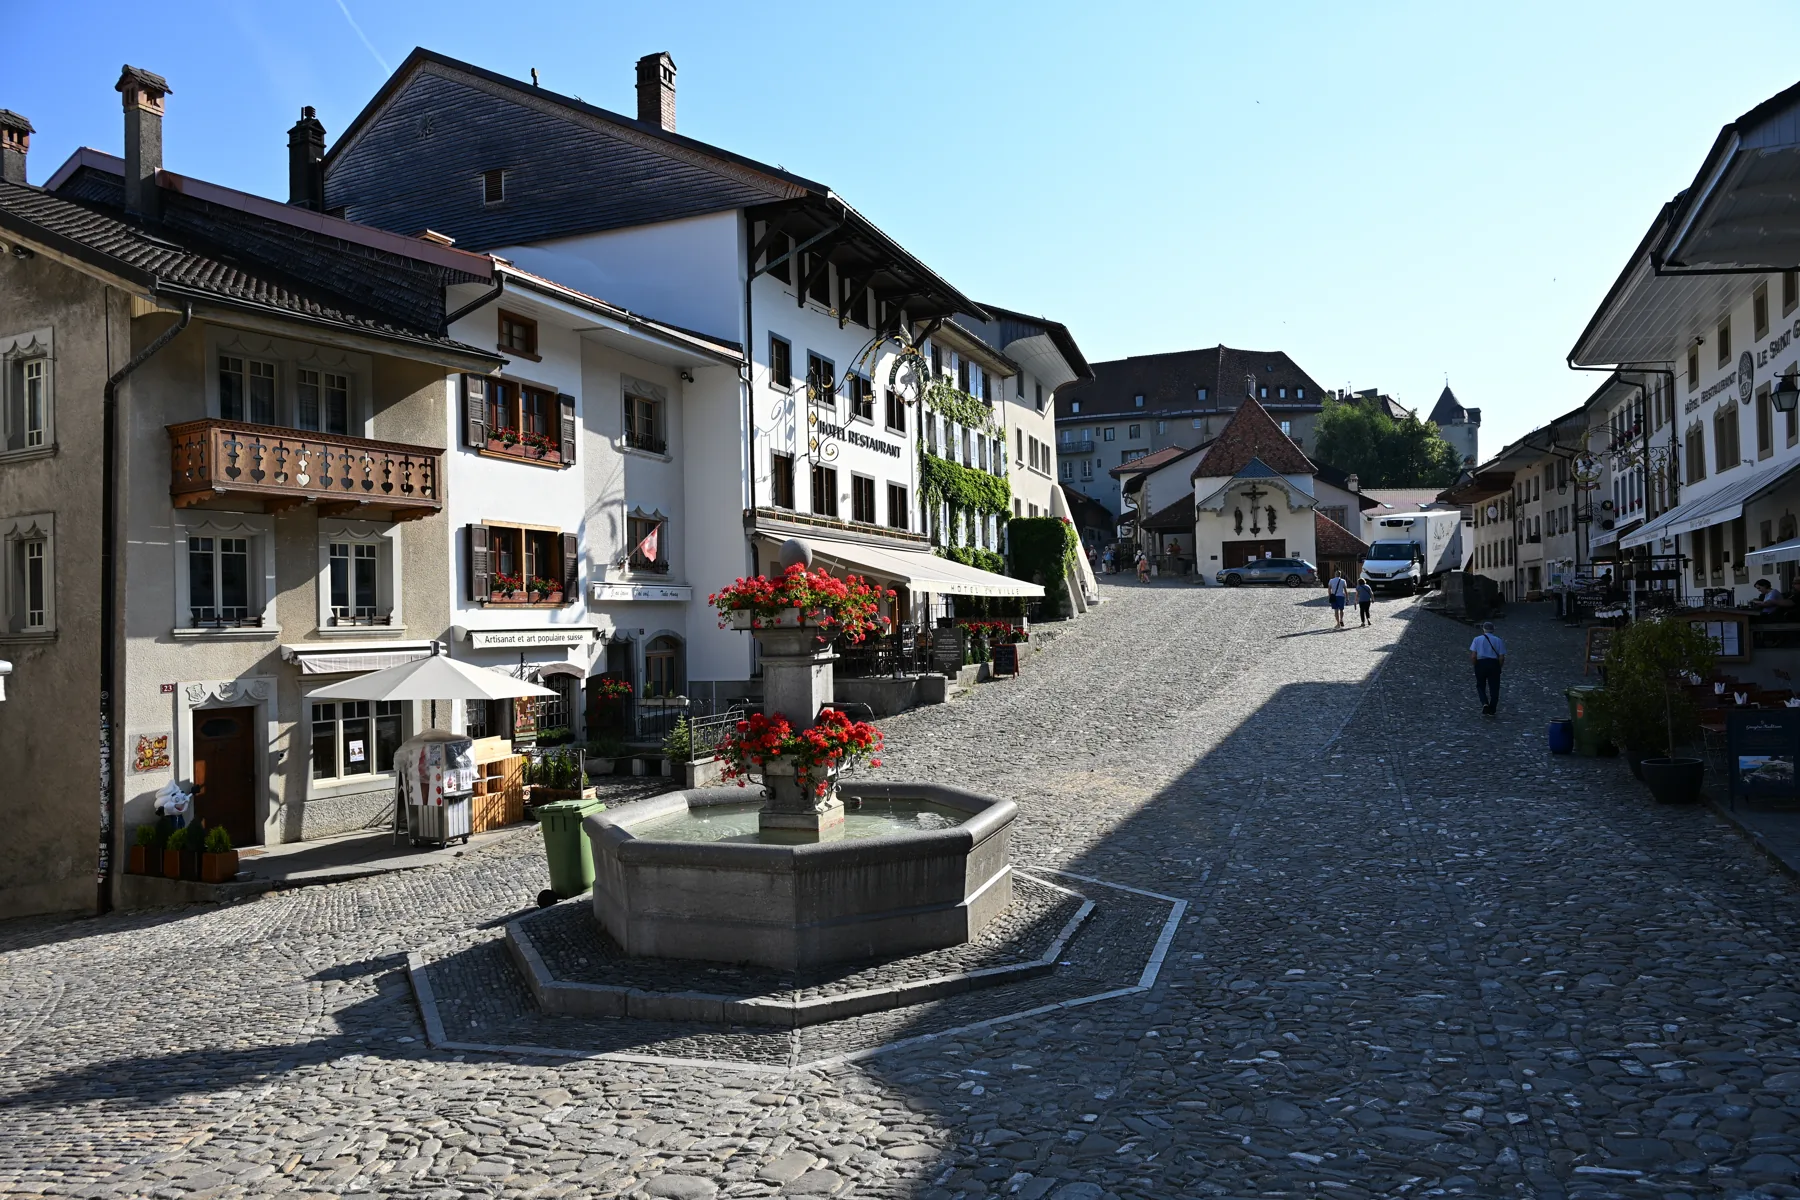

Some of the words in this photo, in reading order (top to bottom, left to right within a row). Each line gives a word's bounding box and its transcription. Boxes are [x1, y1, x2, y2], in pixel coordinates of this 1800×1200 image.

[917, 358, 929, 375] VILLE
[1757, 349, 1768, 369] LE
[1701, 371, 1737, 404] RESTAURANT
[819, 420, 847, 442] HOTEL
[848, 430, 902, 459] RESTAURANT
[951, 585, 979, 594] HOTEL
[485, 635, 515, 644] Artisanat
[517, 635, 524, 643] et
[526, 635, 536, 643] art
[538, 634, 565, 643] populaire
[567, 633, 583, 641] suisse
